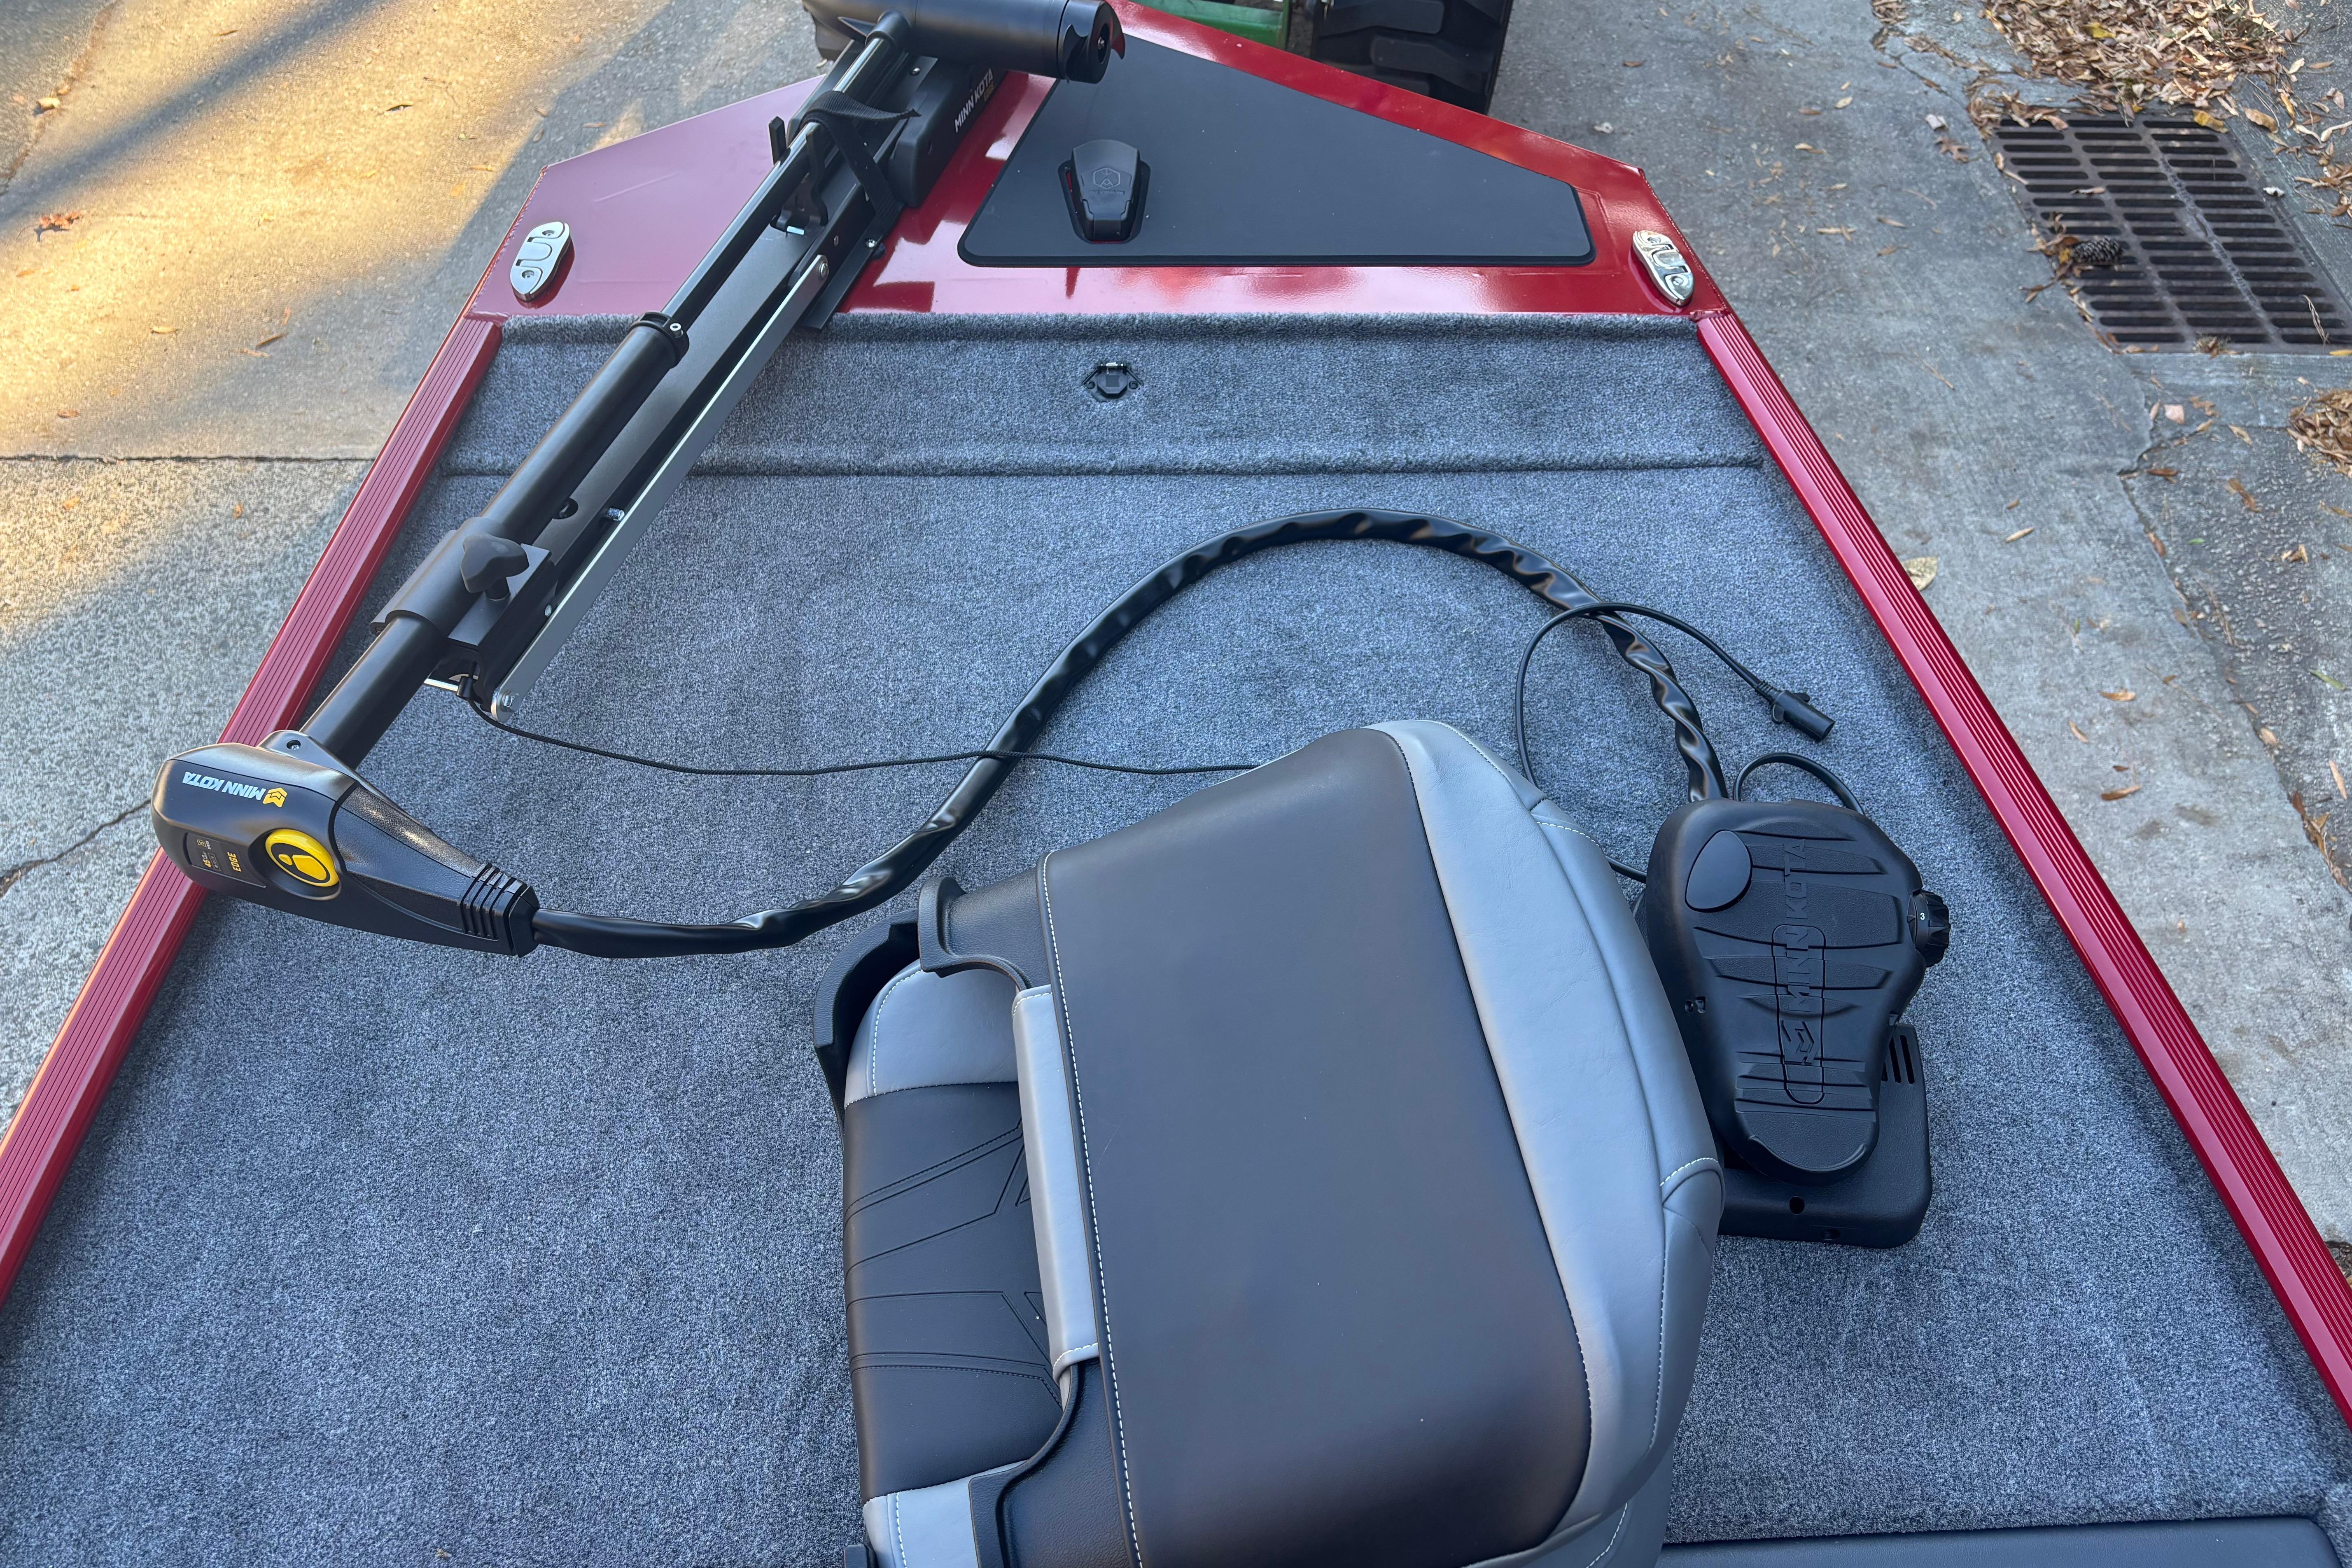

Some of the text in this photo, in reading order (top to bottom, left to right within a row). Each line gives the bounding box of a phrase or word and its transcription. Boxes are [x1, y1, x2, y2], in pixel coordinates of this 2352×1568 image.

[954, 95, 974, 133] MINN
[974, 68, 994, 103] KOTA
[182, 772, 266, 800] MINN KOTA
[203, 859, 212, 868] 45
[227, 852, 242, 872] EDGE
[1784, 839, 1811, 1013] MINN KOTA
